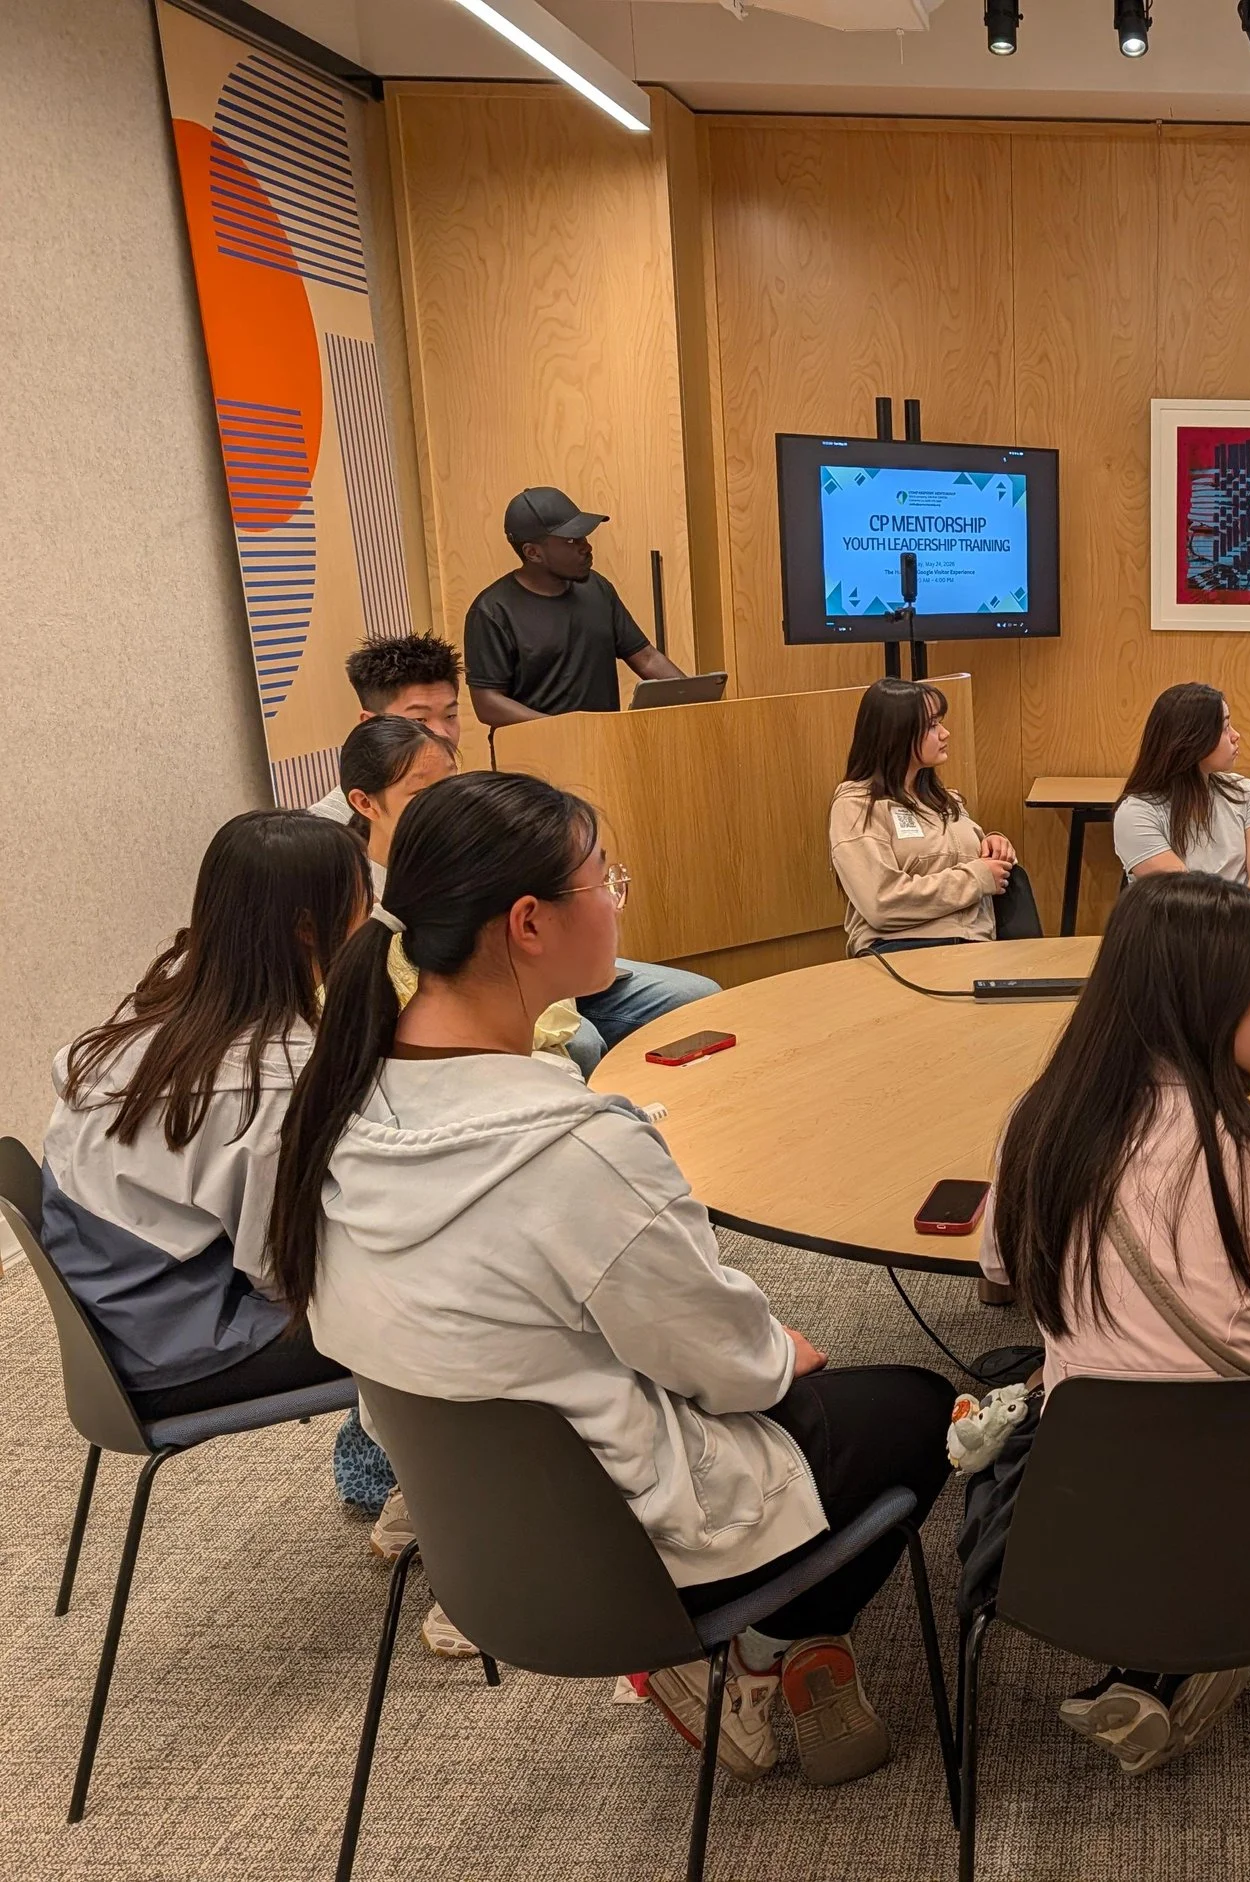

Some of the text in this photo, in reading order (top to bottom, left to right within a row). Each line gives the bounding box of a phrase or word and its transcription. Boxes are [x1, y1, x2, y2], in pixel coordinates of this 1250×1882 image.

[869, 514, 987, 534] CP MENTORSHIP
[842, 537, 1011, 552] YOUTH LEADERSHIP TRAINING
